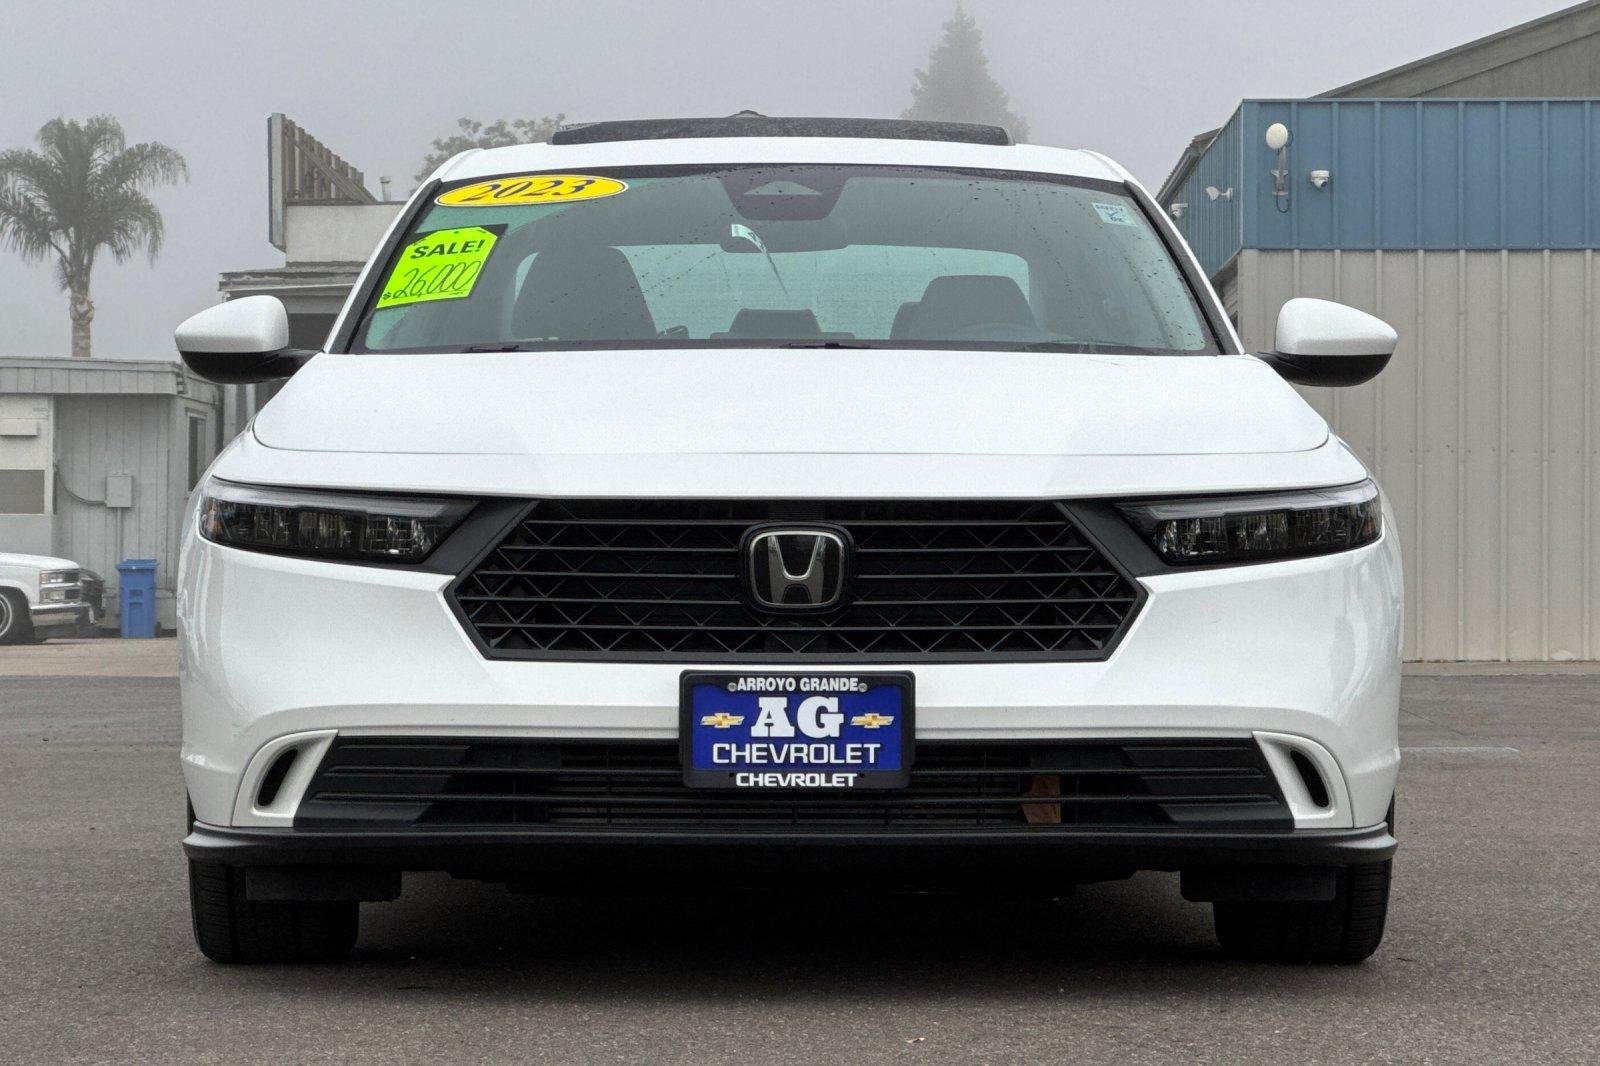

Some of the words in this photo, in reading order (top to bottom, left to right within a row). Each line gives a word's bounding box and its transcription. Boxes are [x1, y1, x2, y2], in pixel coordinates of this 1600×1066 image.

[459, 179, 595, 202] 2023
[410, 239, 486, 259] SALE!
[737, 677, 796, 692] ARROYO
[800, 677, 859, 692] GRANDE
[751, 696, 844, 738] AG
[712, 743, 881, 764] CHEVROLET
[735, 773, 858, 787] CHEVROLET
